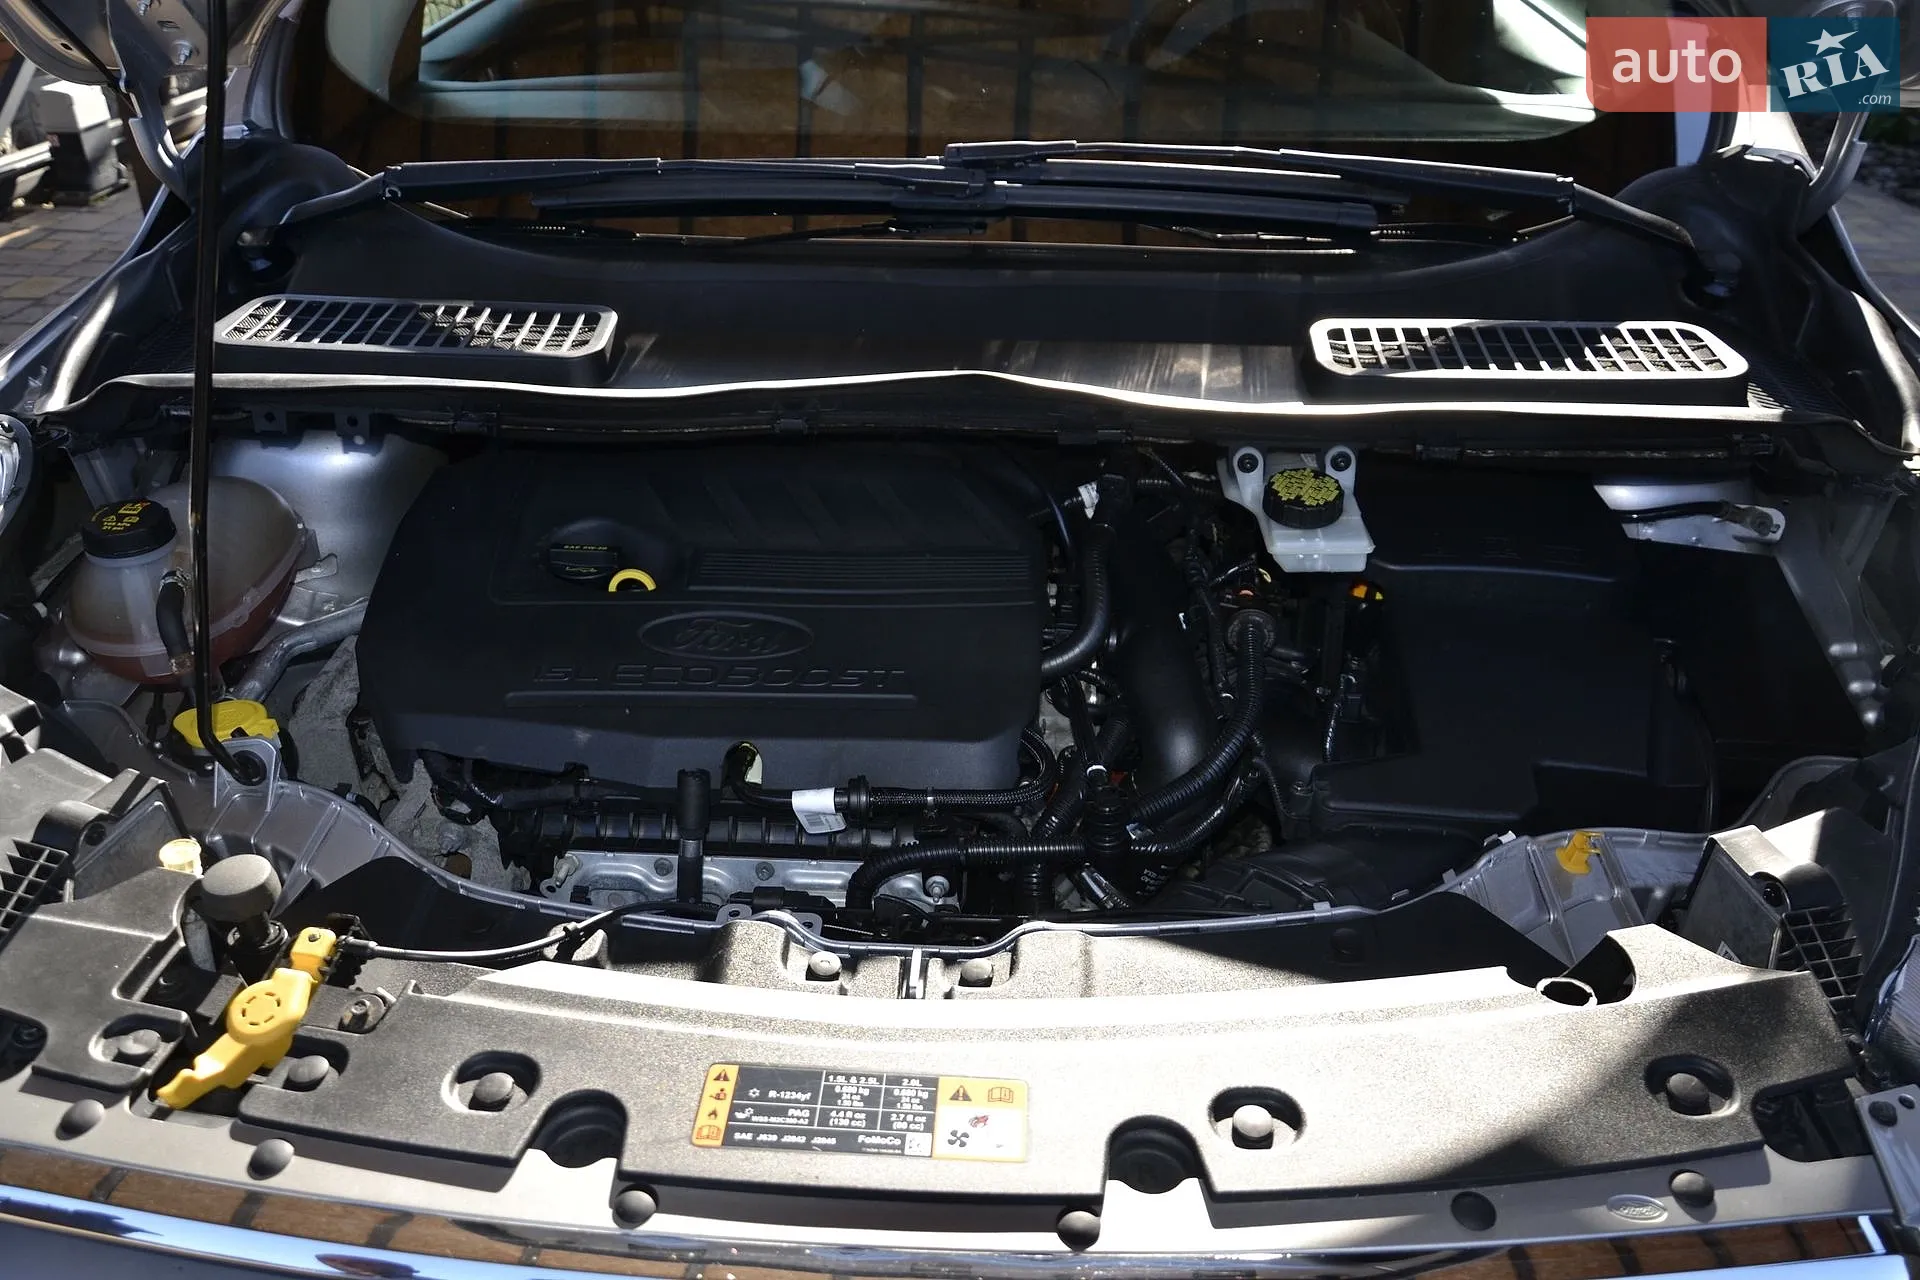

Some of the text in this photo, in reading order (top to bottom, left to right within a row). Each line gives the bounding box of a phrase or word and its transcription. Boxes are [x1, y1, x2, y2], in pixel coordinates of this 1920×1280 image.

[674, 619, 787, 654] Ford
[612, 664, 905, 689] ECOBOOST
[902, 1078, 923, 1086] 2.0L
[858, 1087, 869, 1095] kg
[918, 1090, 929, 1099] kg
[768, 1090, 811, 1101] R-1234yf
[788, 1108, 810, 1117] PAG
[890, 1113, 905, 1121] 2.7
[851, 1119, 866, 1127] cc)
[909, 1123, 924, 1131] cc)
[734, 1132, 753, 1140] SAE
[858, 1134, 902, 1145] FoMoCo
